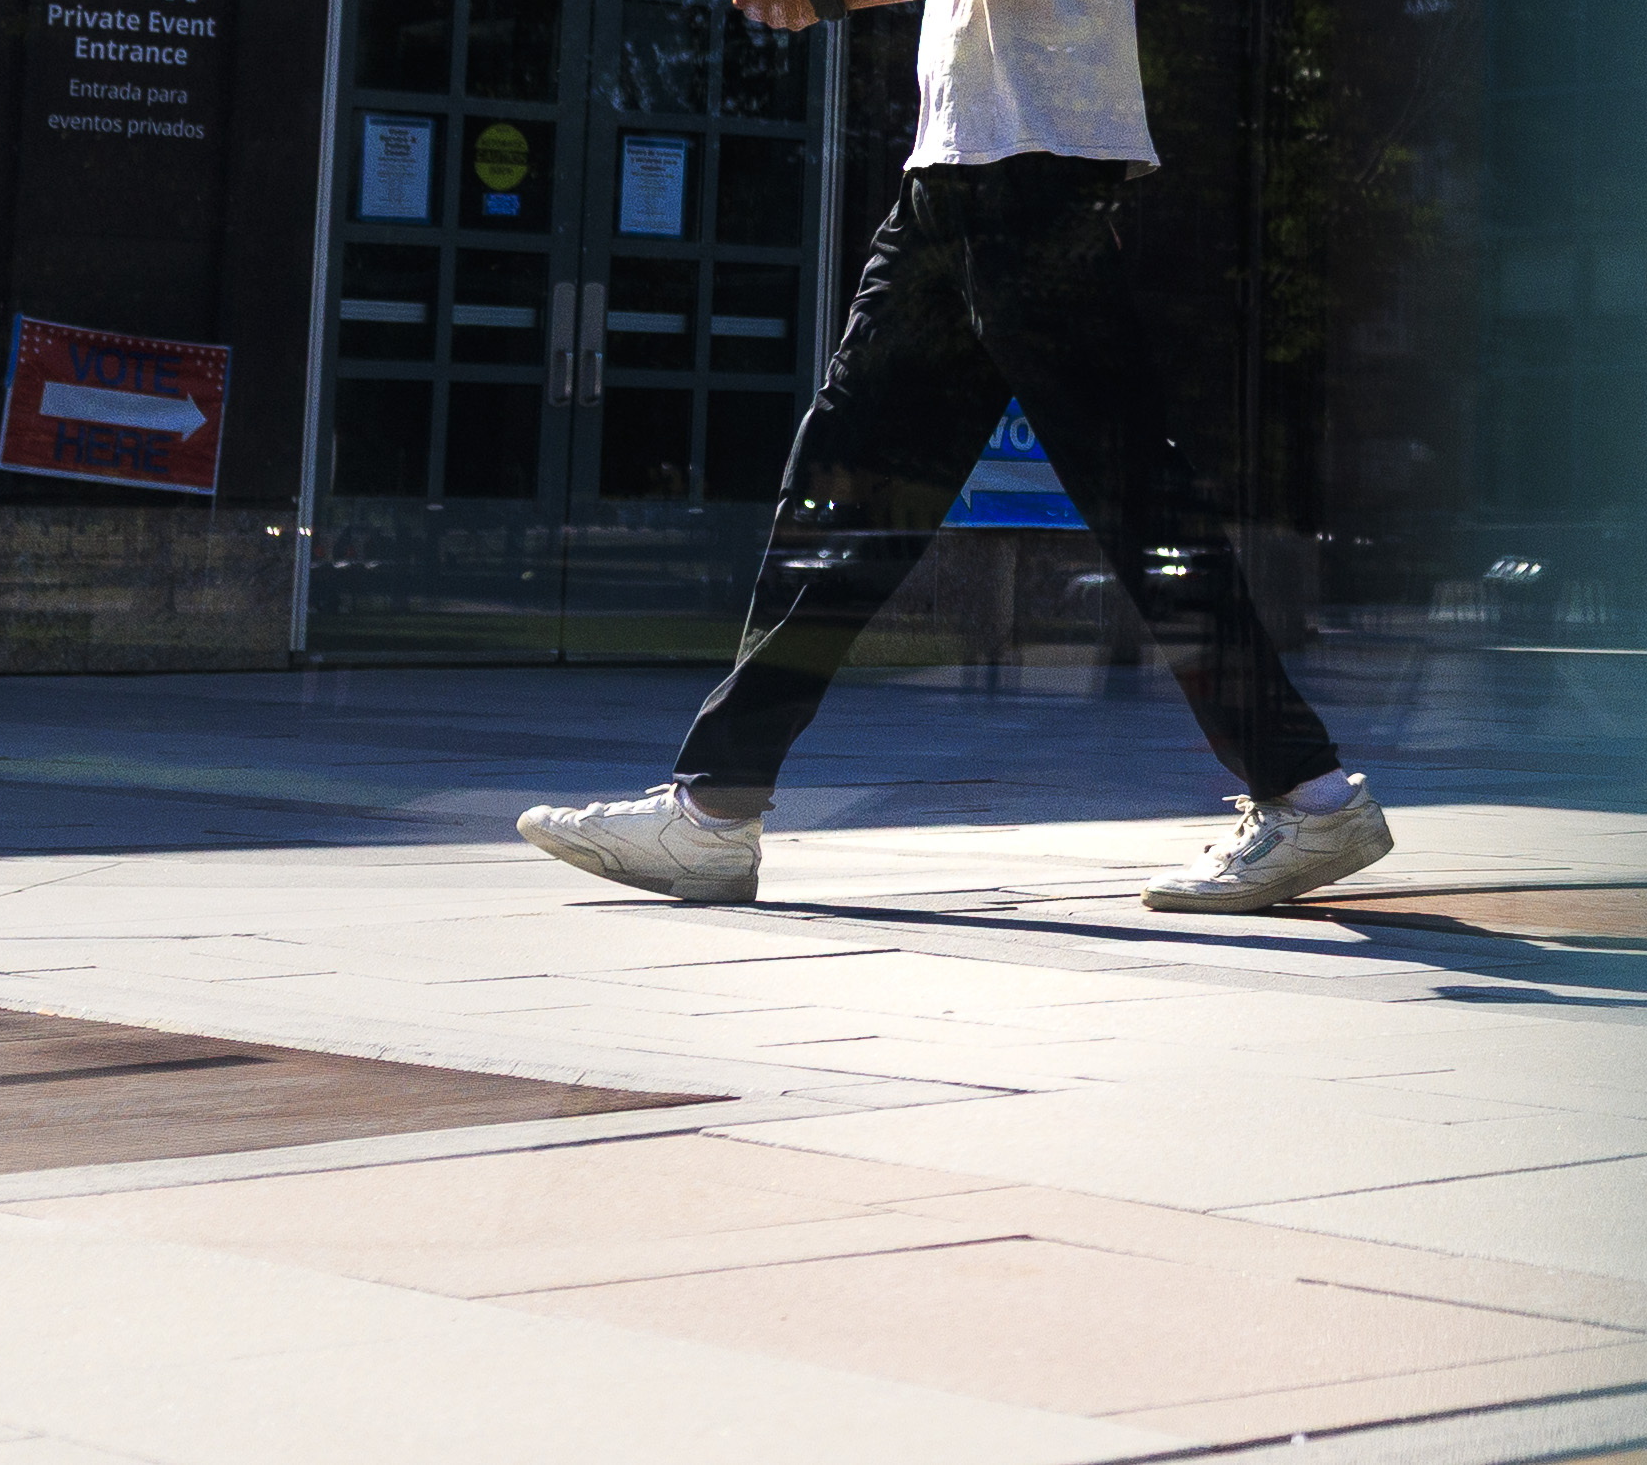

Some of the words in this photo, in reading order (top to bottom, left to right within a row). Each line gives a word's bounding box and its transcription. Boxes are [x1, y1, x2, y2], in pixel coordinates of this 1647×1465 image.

[47, 3, 141, 31] Private
[148, 10, 216, 38] Event
[74, 36, 188, 66] Entrance
[69, 78, 142, 102] Entrada
[147, 86, 188, 107] para
[48, 112, 122, 134] eventos
[127, 118, 205, 140] privados
[69, 342, 182, 395] VOTE
[55, 421, 173, 475] HERE
